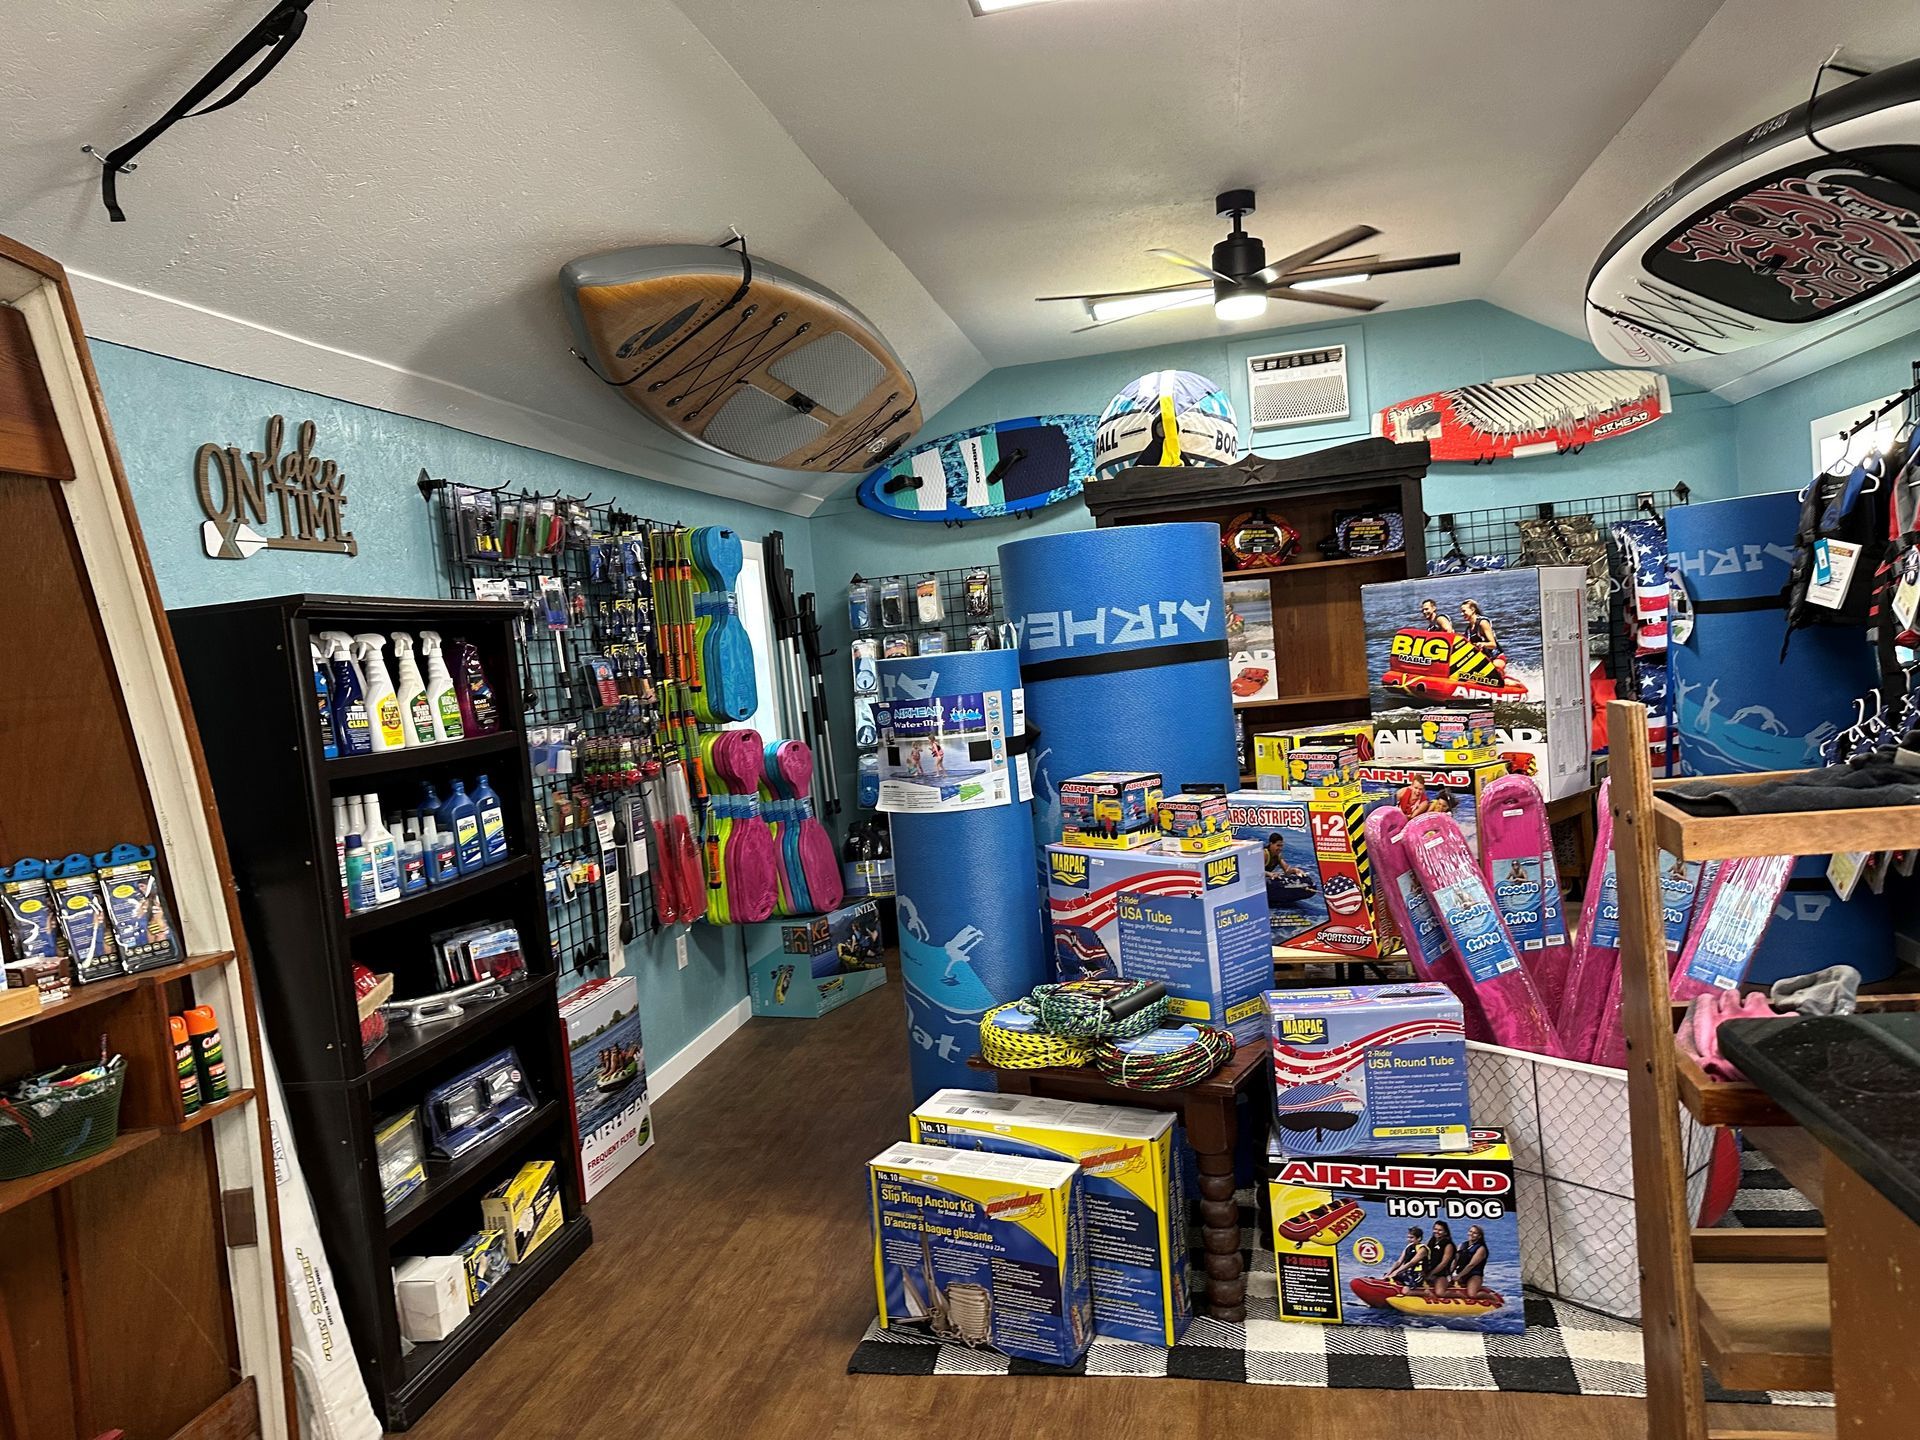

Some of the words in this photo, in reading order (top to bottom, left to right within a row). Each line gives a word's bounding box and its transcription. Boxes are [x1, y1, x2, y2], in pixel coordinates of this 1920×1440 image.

[1592, 411, 1650, 437] AIRHEAD
[262, 414, 346, 492] lake
[1215, 430, 1239, 459] BOO
[971, 442, 981, 484] AIRHEAD
[194, 442, 267, 525] ON
[267, 483, 354, 544] TIME
[1391, 634, 1450, 662] BIG
[1398, 653, 1432, 666] MABLE
[1458, 672, 1500, 687] MABLE
[1421, 714, 1468, 723] AIRHEAD
[1289, 753, 1337, 761] AIRHEAD
[1124, 778, 1162, 791] AIRHEAD
[1358, 769, 1471, 788] AIRHEAD
[1060, 783, 1119, 796] AIRHEAD
[1158, 802, 1200, 812] AIRHEAD
[484, 815, 500, 825] Sierra
[1227, 808, 1248, 826] ARS
[1248, 808, 1258, 826] &
[1258, 808, 1304, 827] STRIPES
[1312, 815, 1346, 837] 1-2
[459, 823, 475, 832] Sierra
[1050, 853, 1087, 874] MARPAC
[1207, 856, 1237, 876] MARPAC
[1497, 882, 1541, 897] noodle
[1659, 877, 1694, 894] oodle
[854, 900, 878, 917] INTEX
[1119, 895, 1139, 905] 2-Rider
[1119, 905, 1143, 920] USA
[1144, 908, 1173, 924] Tube
[1216, 917, 1232, 928] USA
[1232, 912, 1249, 923] Tubo
[1449, 903, 1491, 926] noodle
[1504, 910, 1538, 925] frite
[811, 919, 830, 942] K2
[1316, 932, 1373, 946] SPORTSSTUFF
[1465, 932, 1501, 952] frite
[1283, 1018, 1323, 1035] MARPAC
[911, 1024, 961, 1064] at
[1367, 1050, 1393, 1059] 2-Rider
[1368, 1059, 1392, 1069] USA
[1394, 1058, 1427, 1068] Round
[1429, 1056, 1455, 1066] Tube
[582, 1093, 648, 1150] AIRHEAD
[920, 1121, 934, 1132] No.
[935, 1123, 946, 1134] 13
[587, 1139, 620, 1171] FREQUENT
[619, 1127, 637, 1146] FLYER
[877, 1171, 889, 1181] No.
[890, 1173, 898, 1182] 10
[1275, 1160, 1511, 1195] AIRHEAD
[881, 1188, 900, 1203] Slip
[901, 1191, 923, 1207] Ring
[924, 1195, 959, 1211] Anchor
[960, 1200, 976, 1213] Kit
[1388, 1198, 1441, 1218] HOT
[1448, 1199, 1503, 1219] DOG
[884, 1215, 917, 1230] D'ancre
[918, 1220, 924, 1231] à
[925, 1221, 952, 1236] bague
[953, 1228, 994, 1243] glissante
[1328, 1217, 1353, 1237] HOT
